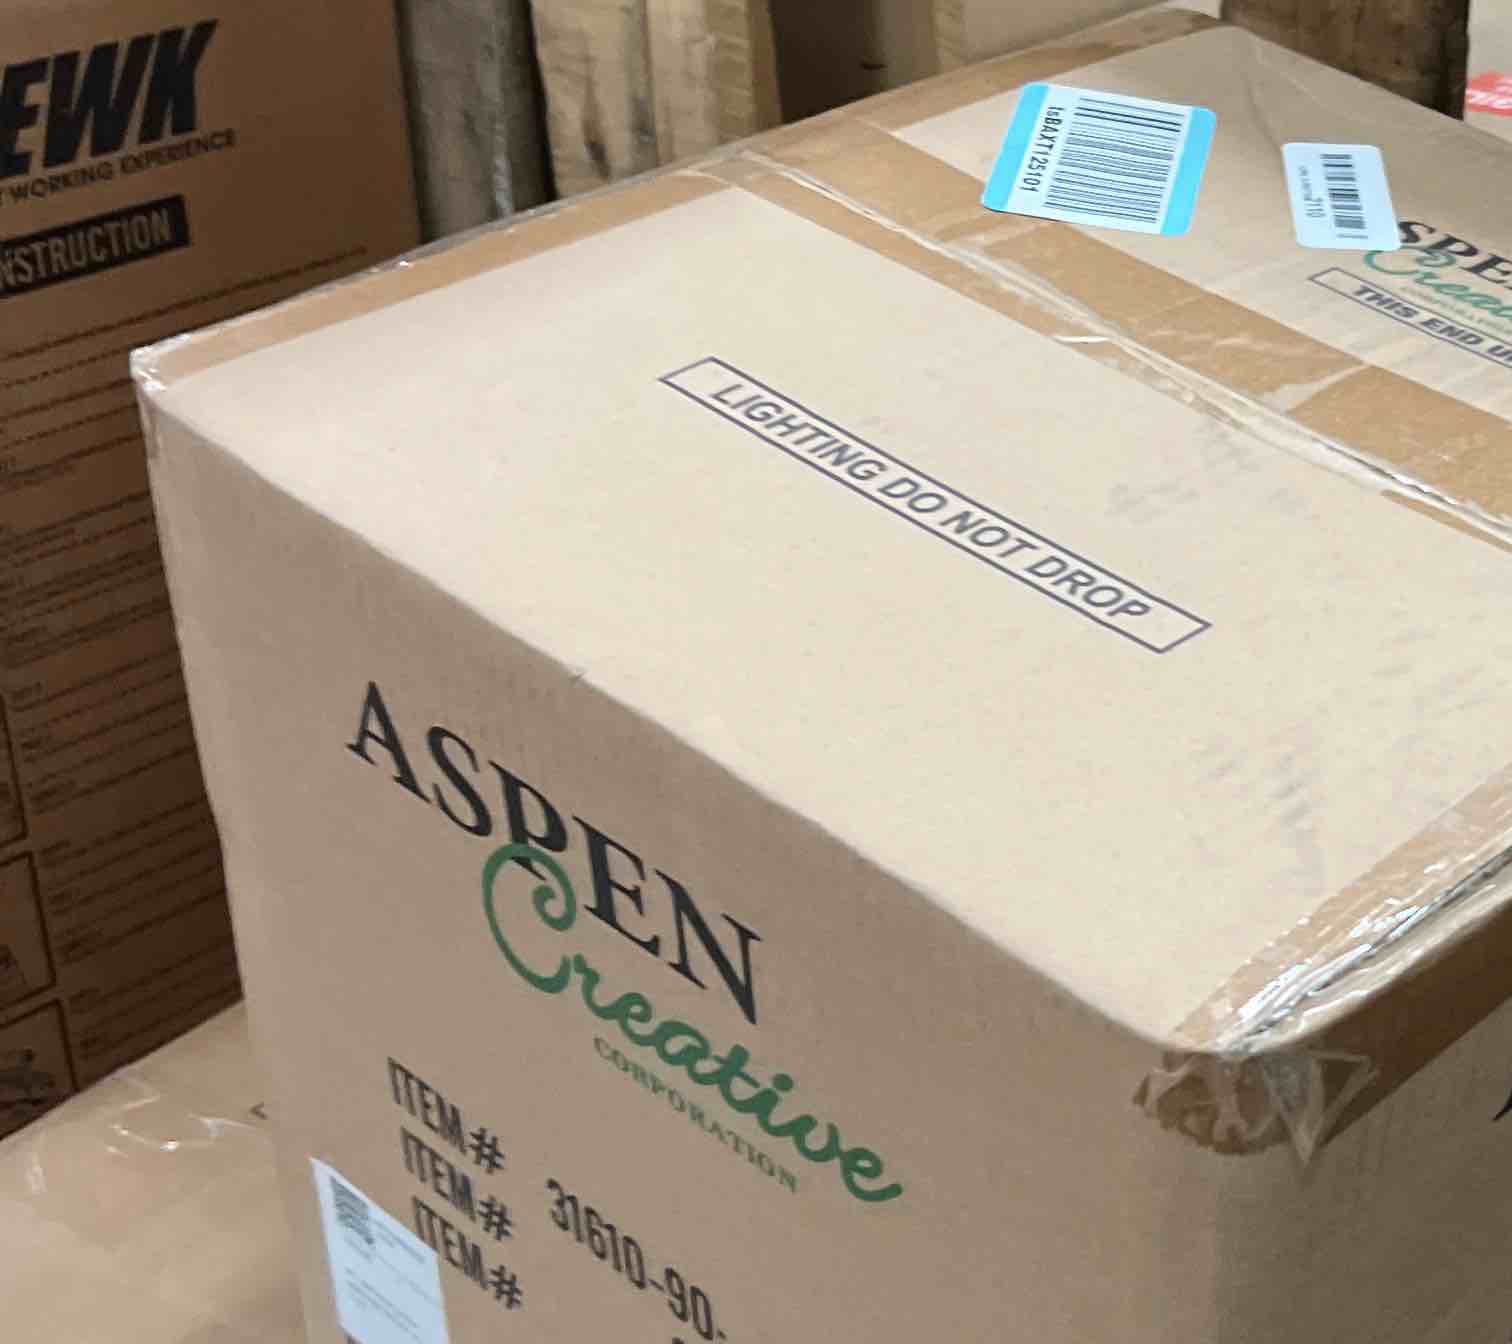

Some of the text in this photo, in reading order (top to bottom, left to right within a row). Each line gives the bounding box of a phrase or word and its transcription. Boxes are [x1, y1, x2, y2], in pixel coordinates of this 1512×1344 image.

[1353, 285, 1420, 320] THIS
[1420, 317, 1484, 346] END
[709, 382, 1152, 622] LIGHTING DO NOT DROP
[346, 680, 763, 1025] ASPEN
[481, 842, 904, 1203] Creative
[593, 1036, 799, 1193] CORPORATION
